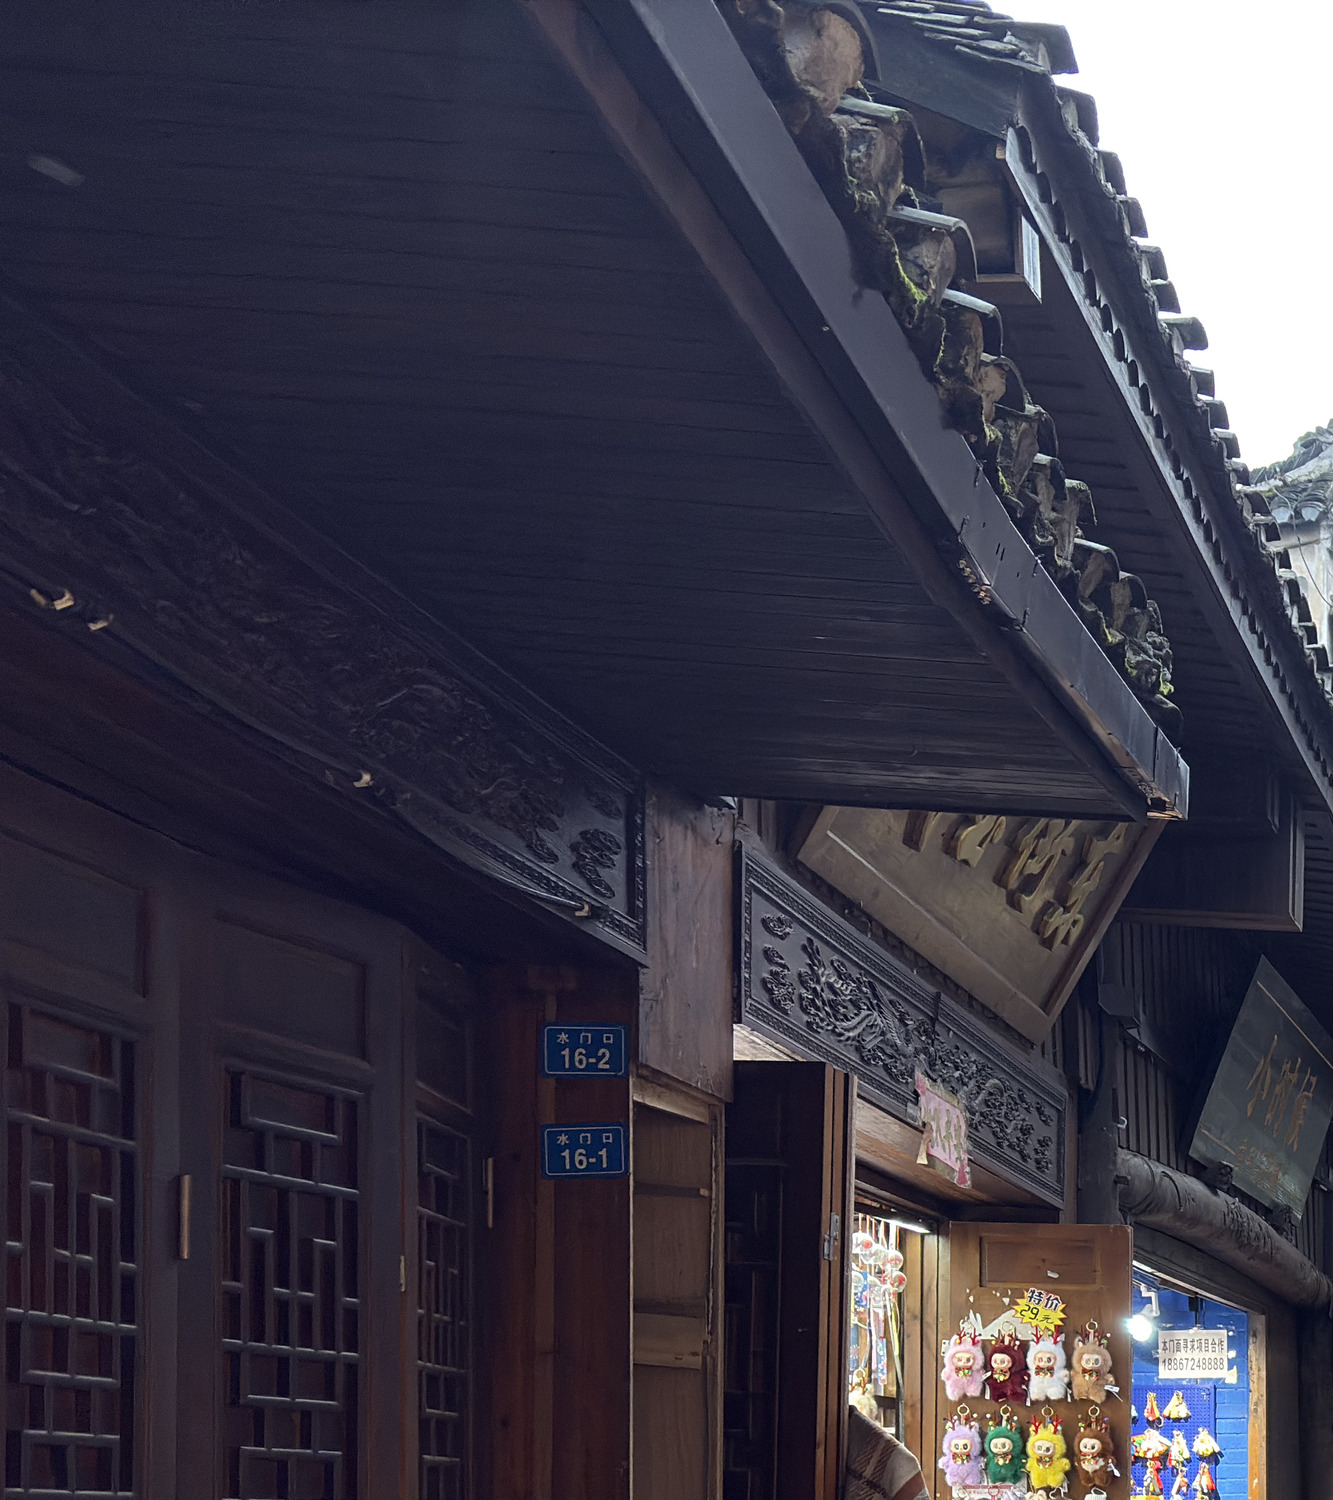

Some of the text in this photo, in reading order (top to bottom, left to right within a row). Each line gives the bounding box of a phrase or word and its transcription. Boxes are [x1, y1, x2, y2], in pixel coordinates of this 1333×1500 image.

[556, 1031, 614, 1045] 水门口
[560, 1048, 611, 1070] 16-2
[556, 1132, 614, 1145] 水门口
[560, 1149, 609, 1170] 16-1
[1027, 1289, 1061, 1312] 特价
[1161, 1338, 1225, 1354] 本门面寻求项目合作
[1161, 1357, 1225, 1371] 18867248888
